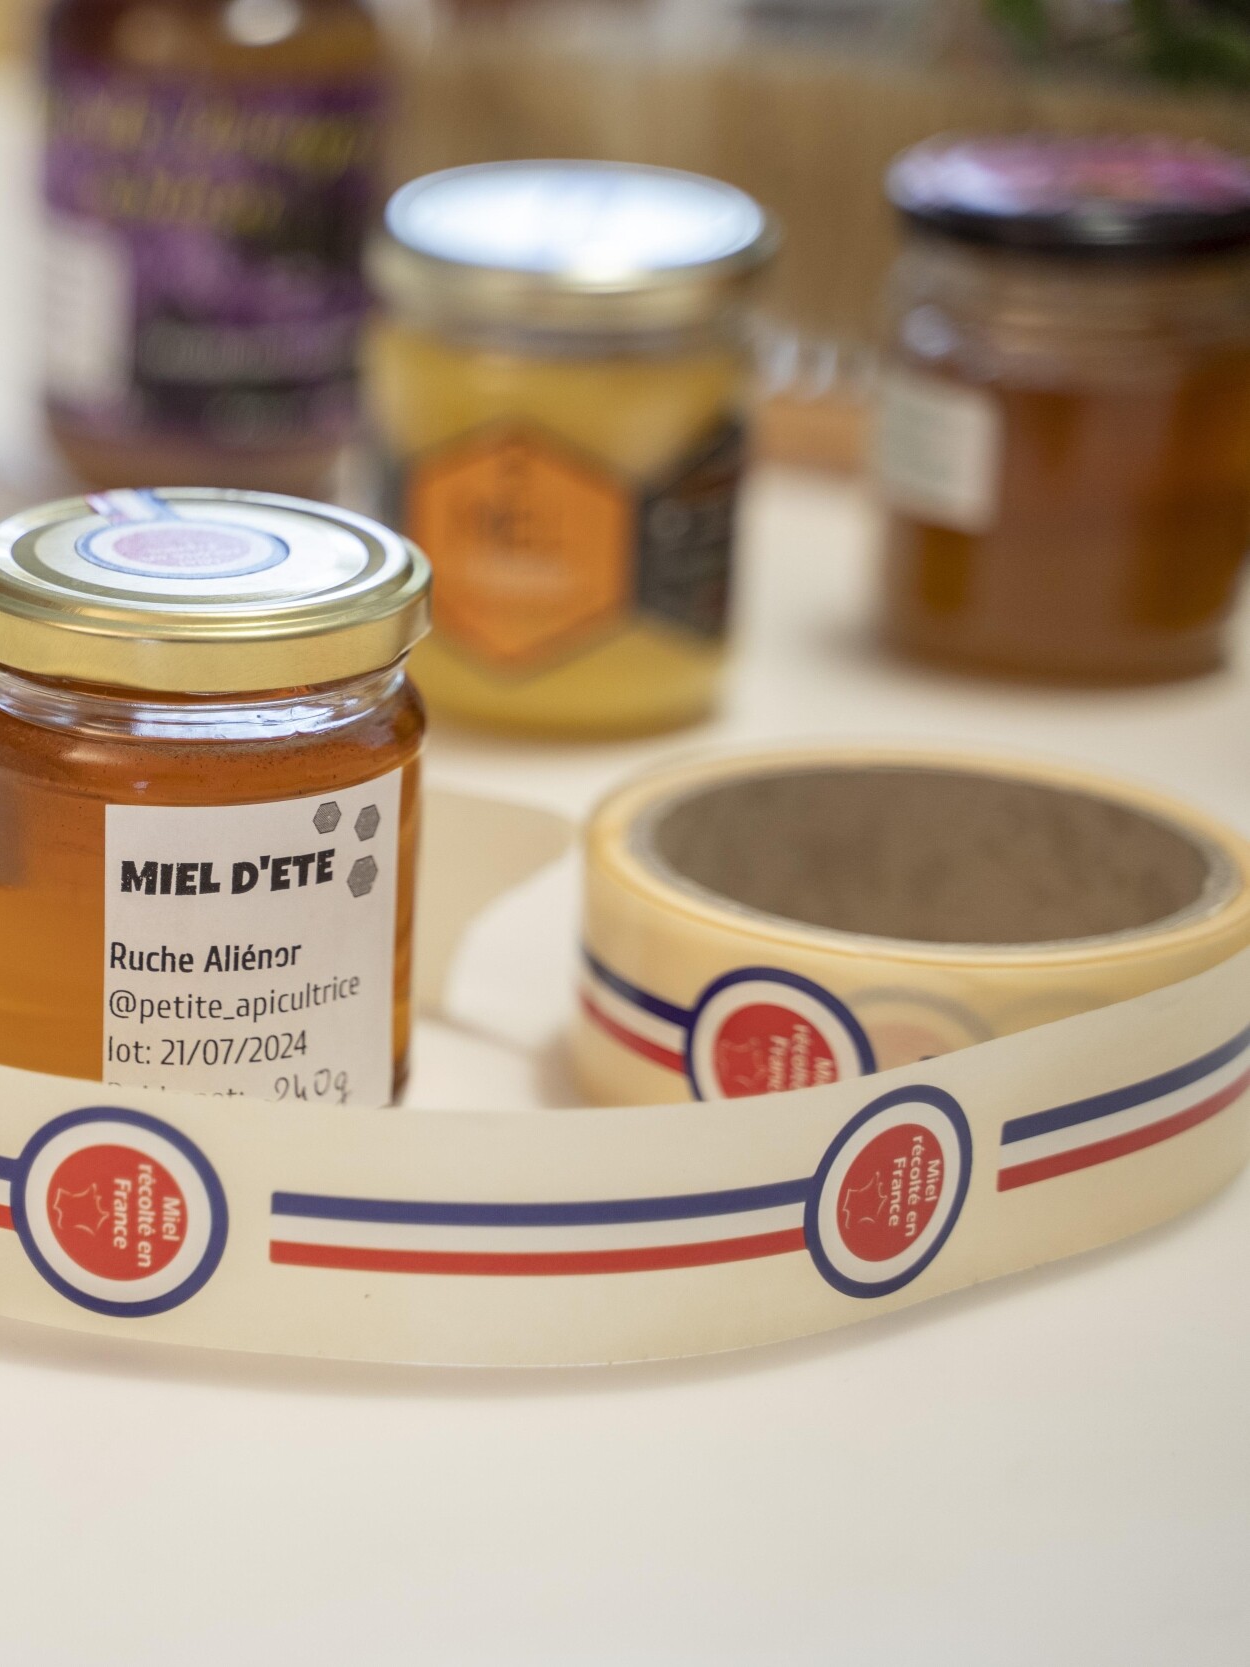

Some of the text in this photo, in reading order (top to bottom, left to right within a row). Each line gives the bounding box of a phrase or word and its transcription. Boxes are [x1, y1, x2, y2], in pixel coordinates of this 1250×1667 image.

[120, 848, 335, 895] MIEL D'ETE
[110, 941, 302, 973] Ruche Aliénor
[109, 975, 361, 1024] @petite_apicultrice
[108, 1030, 307, 1066] lot: 21/07/2024
[888, 1157, 907, 1227] France
[904, 1135, 923, 1237] récolté en
[925, 1158, 941, 1203] Miel
[113, 1178, 132, 1250] France
[137, 1163, 157, 1268] récolté en
[161, 1196, 181, 1242] Miel
